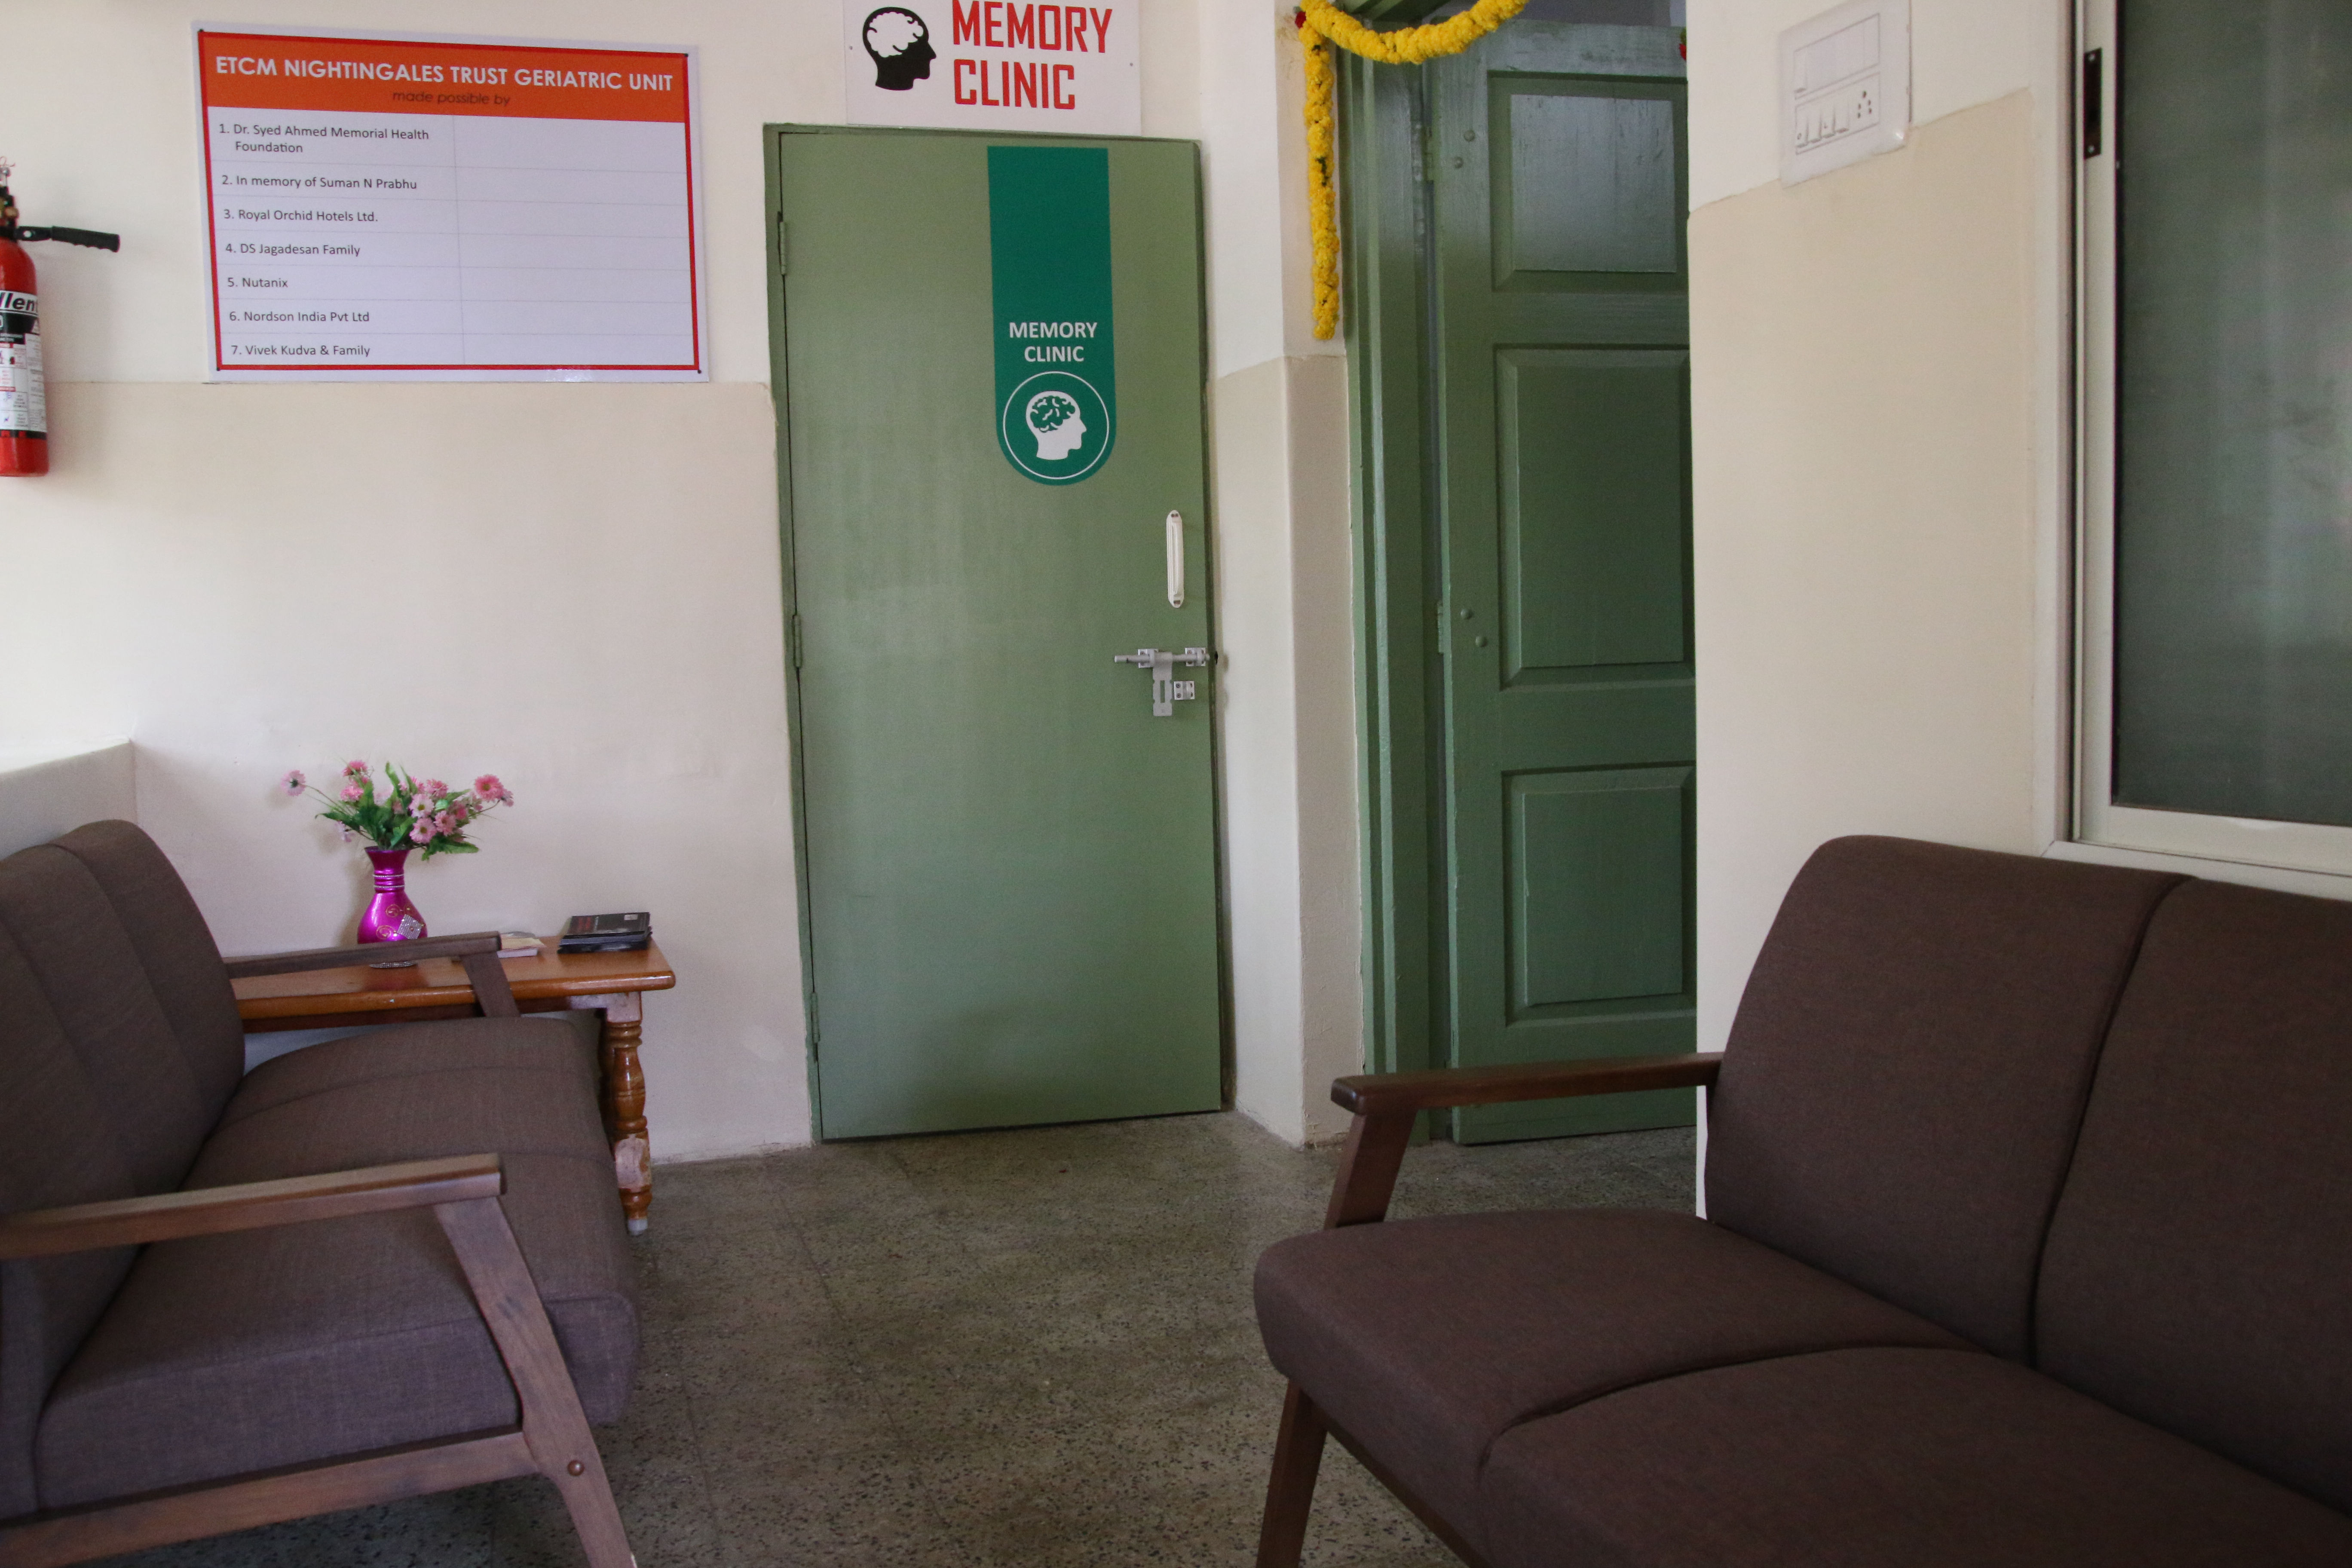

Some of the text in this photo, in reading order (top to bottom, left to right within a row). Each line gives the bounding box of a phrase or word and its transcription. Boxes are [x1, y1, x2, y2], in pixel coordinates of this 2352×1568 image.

[952, 0, 1112, 53] MEMORY
[216, 56, 673, 90] ETCM NIGHTINGALES TRUST GERIATRIC UNIT
[954, 59, 1075, 110] CLINIC
[393, 92, 510, 107] made possible by
[220, 124, 429, 139] 1. Dr. Syed Ahmed Memorial Health
[236, 141, 303, 153] Foundation
[222, 175, 416, 189] 2. In memory of Suman N Prabhu
[224, 209, 377, 221] 3. Royal Orchid Hotels Ltd.
[226, 244, 360, 257] 4. DS Jagadesan Family
[228, 277, 288, 287] 5. Nutanix
[230, 312, 369, 322] 6. Nordson India Pvt Ltd
[1010, 322, 1097, 338] MEMORY
[231, 345, 370, 357] 7. Vivek Kudva & Family
[1025, 346, 1084, 362] CLINIC
